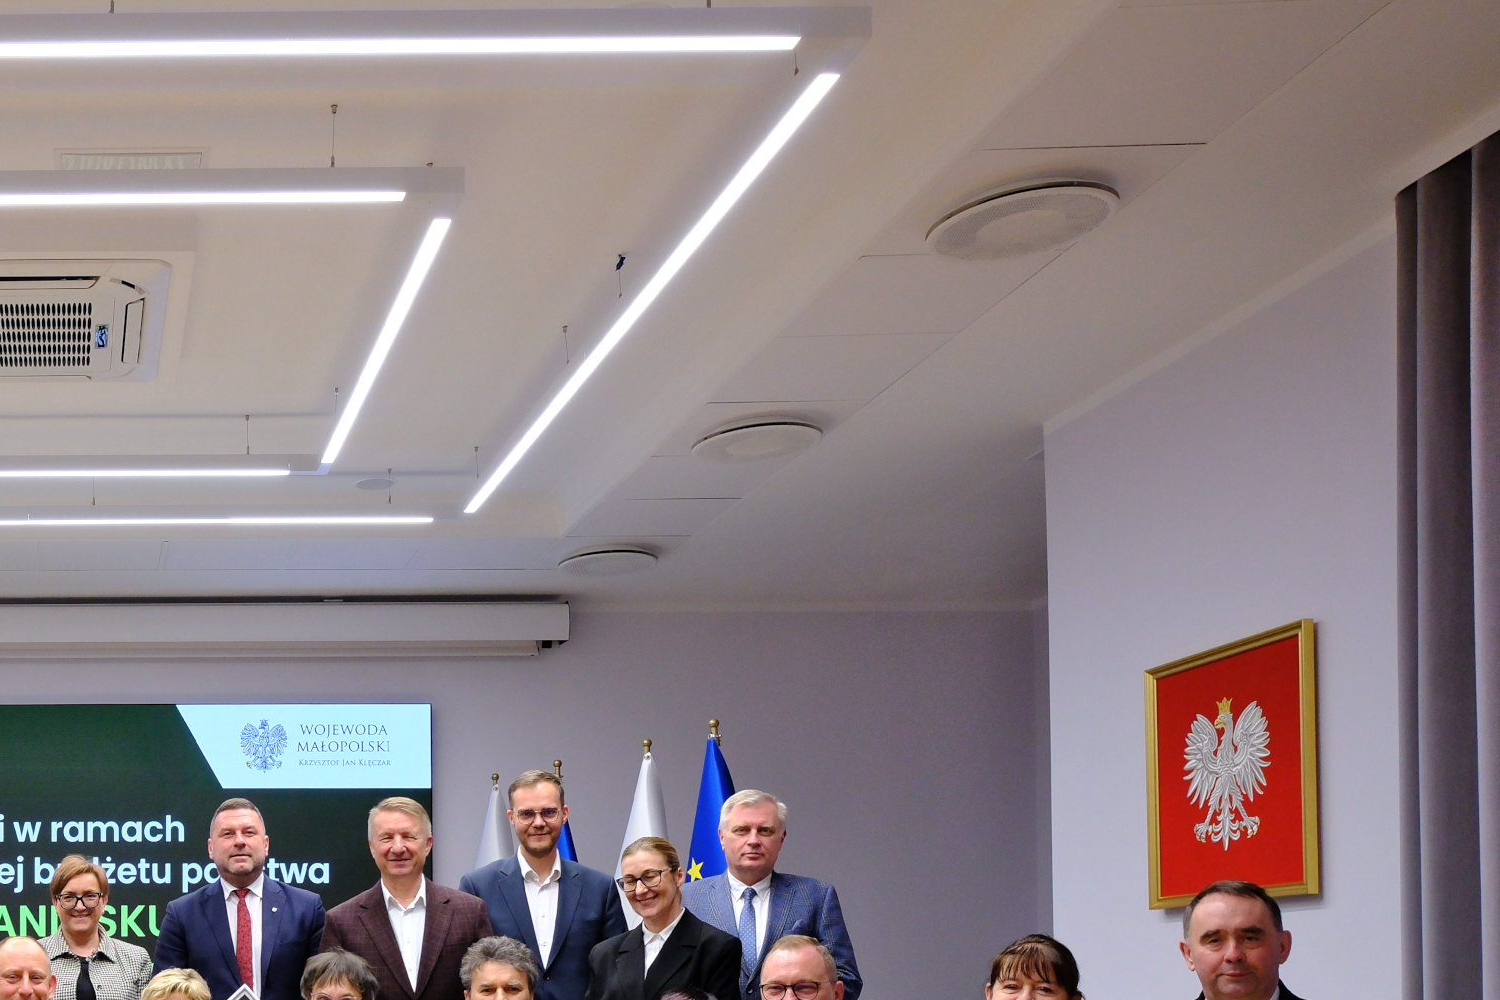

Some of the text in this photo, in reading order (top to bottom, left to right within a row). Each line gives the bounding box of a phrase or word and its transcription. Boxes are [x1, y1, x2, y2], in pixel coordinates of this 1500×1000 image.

[300, 724, 388, 737] WOJEWODA
[297, 740, 390, 752] MAŁOPOLSKI
[298, 759, 339, 767] KRZYSZTOF
[342, 759, 356, 767] JAN
[13, 821, 42, 843] w
[50, 815, 185, 843] ramach
[34, 855, 171, 885] bżetu
[182, 857, 330, 893] patwa
